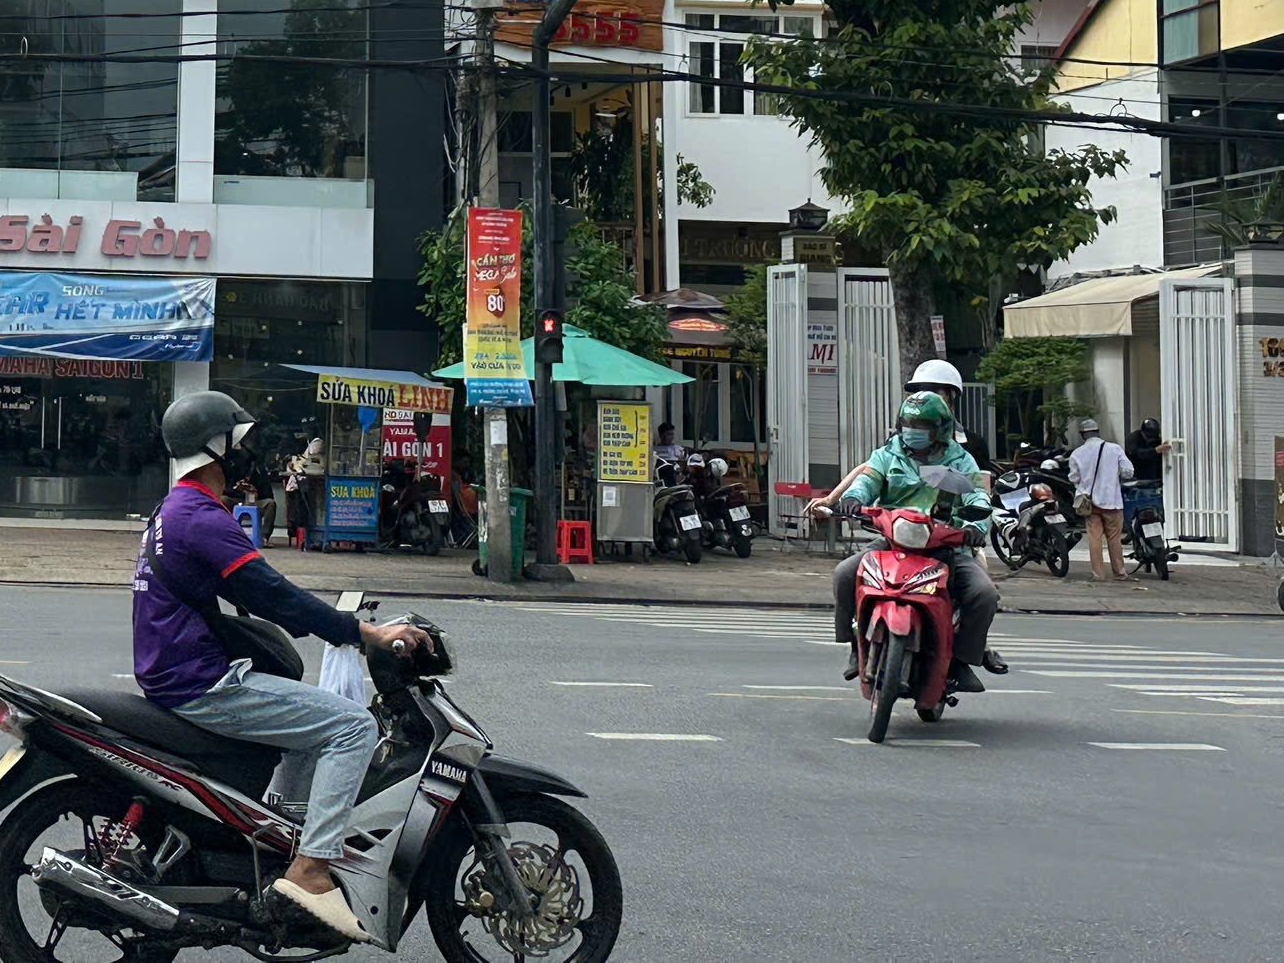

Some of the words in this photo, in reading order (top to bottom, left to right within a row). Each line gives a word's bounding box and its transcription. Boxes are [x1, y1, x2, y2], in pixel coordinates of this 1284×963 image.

[101, 217, 211, 258] Gòn
[487, 294, 504, 312] 80
[320, 376, 353, 403] SỬA
[397, 384, 451, 414] LINH
[383, 439, 397, 457] ÀI
[402, 439, 432, 458] GÒN
[436, 442, 444, 458] 1
[431, 760, 467, 783] YAMAHA
